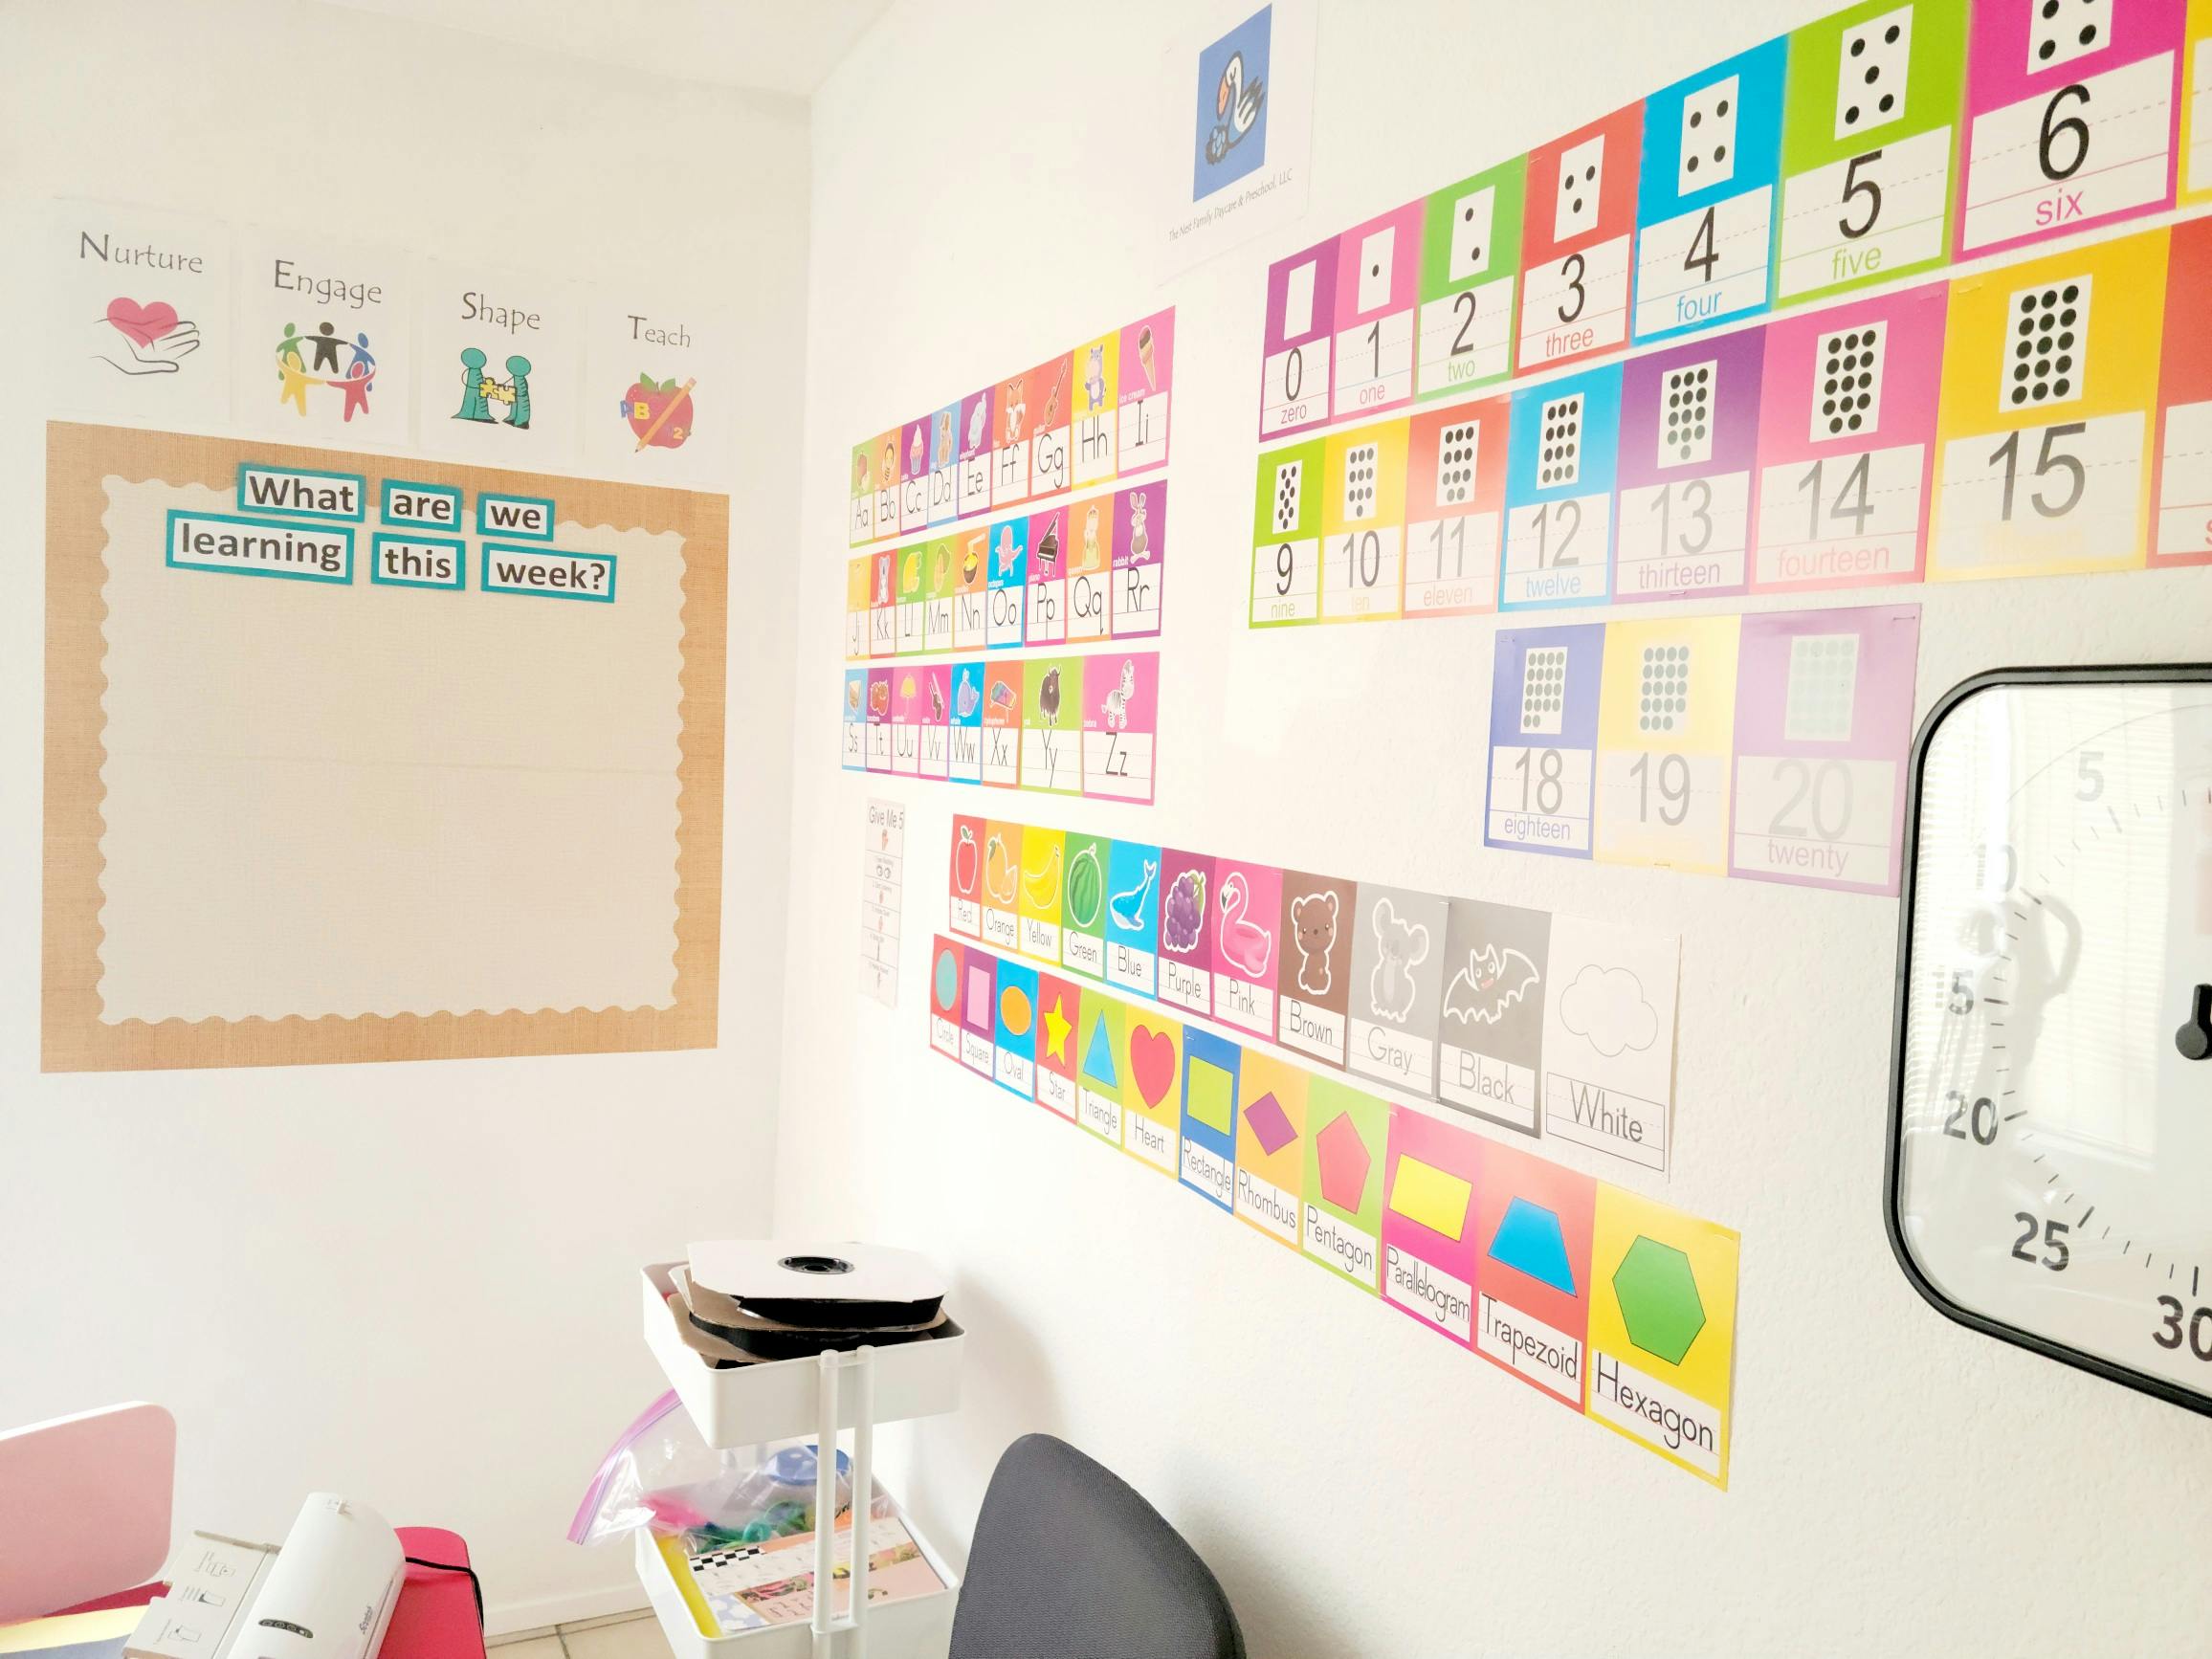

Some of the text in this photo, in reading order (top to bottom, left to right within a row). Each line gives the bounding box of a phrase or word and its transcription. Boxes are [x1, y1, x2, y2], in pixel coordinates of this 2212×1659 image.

[2039, 83, 2090, 181] 6
[1279, 168, 1293, 186] LLC
[1839, 149, 1883, 239] 5
[2036, 188, 2084, 227] six
[79, 231, 204, 276] Nurture
[1683, 206, 1719, 282] 4
[1832, 243, 1881, 280] five
[274, 258, 382, 309] Engage
[1558, 254, 1585, 323] 3
[1676, 289, 1723, 321] four
[462, 292, 542, 334] Shape
[627, 315, 692, 348] Teach
[1450, 292, 1476, 357] 2
[1367, 321, 1380, 378] 1
[1545, 325, 1594, 359] three
[1286, 347, 1302, 401] 0
[1448, 358, 1475, 383] two
[1280, 405, 1307, 425] zero
[1360, 383, 1385, 406] one
[1082, 415, 1107, 463] Hh
[1136, 400, 1148, 447] Ii
[968, 457, 983, 496] Ee
[1002, 443, 1019, 486] Ff
[1038, 433, 1063, 488] Gg
[1989, 422, 2086, 521] 15
[249, 476, 542, 530] What are we
[881, 486, 896, 521] Bb
[906, 480, 921, 514] Cc
[934, 465, 951, 505] Dd
[1798, 453, 1874, 540] 14
[855, 498, 868, 526] Aa
[1649, 479, 1713, 556] 13
[1430, 516, 1466, 579] 11
[1532, 499, 1582, 569] 12
[181, 522, 607, 590] learning this week?
[1113, 556, 1129, 567] rabbit
[1276, 543, 1294, 595] 9
[1342, 530, 1381, 588] 10
[1639, 561, 1720, 589] thirteen
[1777, 544, 1891, 578] fourteen
[1073, 576, 1103, 635] Qq
[1127, 567, 1149, 612] Rr
[1424, 585, 1473, 608] eleven
[1526, 573, 1582, 598] twelve
[876, 608, 890, 640] Kk
[929, 599, 949, 634] Mm
[962, 593, 980, 631] Nn
[993, 588, 1016, 627] Oo
[1037, 582, 1055, 640] Pp
[1271, 601, 1295, 619] nine
[849, 722, 858, 753] Ss
[874, 722, 884, 755] Tt
[897, 723, 913, 758] Uu
[927, 725, 940, 761] Vv
[953, 724, 975, 763] Ww
[991, 727, 1007, 765] Xx
[1042, 728, 1057, 788] Yy
[1105, 732, 1128, 776] Zz
[1515, 747, 1563, 815] 18
[1629, 752, 1691, 827] 19
[2075, 751, 2104, 802] 5
[868, 806, 885, 827] Give
[886, 811, 897, 829] Me
[1768, 758, 1853, 841] 20
[1504, 814, 1571, 842] eighteen
[1768, 839, 1849, 877] twenty
[958, 897, 972, 918] Red
[986, 908, 1014, 945] Orange
[1027, 919, 1051, 948] Yellow
[1069, 927, 1097, 962] Green
[1117, 945, 1141, 978] Blue
[1168, 962, 1202, 1005] Purple
[1229, 979, 1255, 1015] Pink
[937, 1018, 954, 1046] Circle
[1290, 1000, 1333, 1045] Brown
[965, 1036, 988, 1065] Square
[1004, 1051, 1024, 1080] Oval
[1367, 1027, 1413, 1076] Gray
[1049, 1072, 1066, 1100] Star
[1459, 1051, 1514, 1103] Black
[1082, 1087, 1117, 1135] Triangle
[1570, 1080, 1643, 1143] White
[1942, 1090, 1998, 1145] 20
[1135, 1114, 1164, 1154] Heart
[1183, 1138, 1231, 1198] Rectangle
[1238, 1169, 1296, 1229] Rhombus
[1306, 1206, 1373, 1272] Pentagon
[2011, 1211, 2069, 1272] 25
[1386, 1246, 1470, 1323] Parallelogram
[1481, 1293, 1578, 1381] Trapezoid
[2152, 1294, 2212, 1362] 30
[1597, 1352, 1714, 1452] Hexagon
